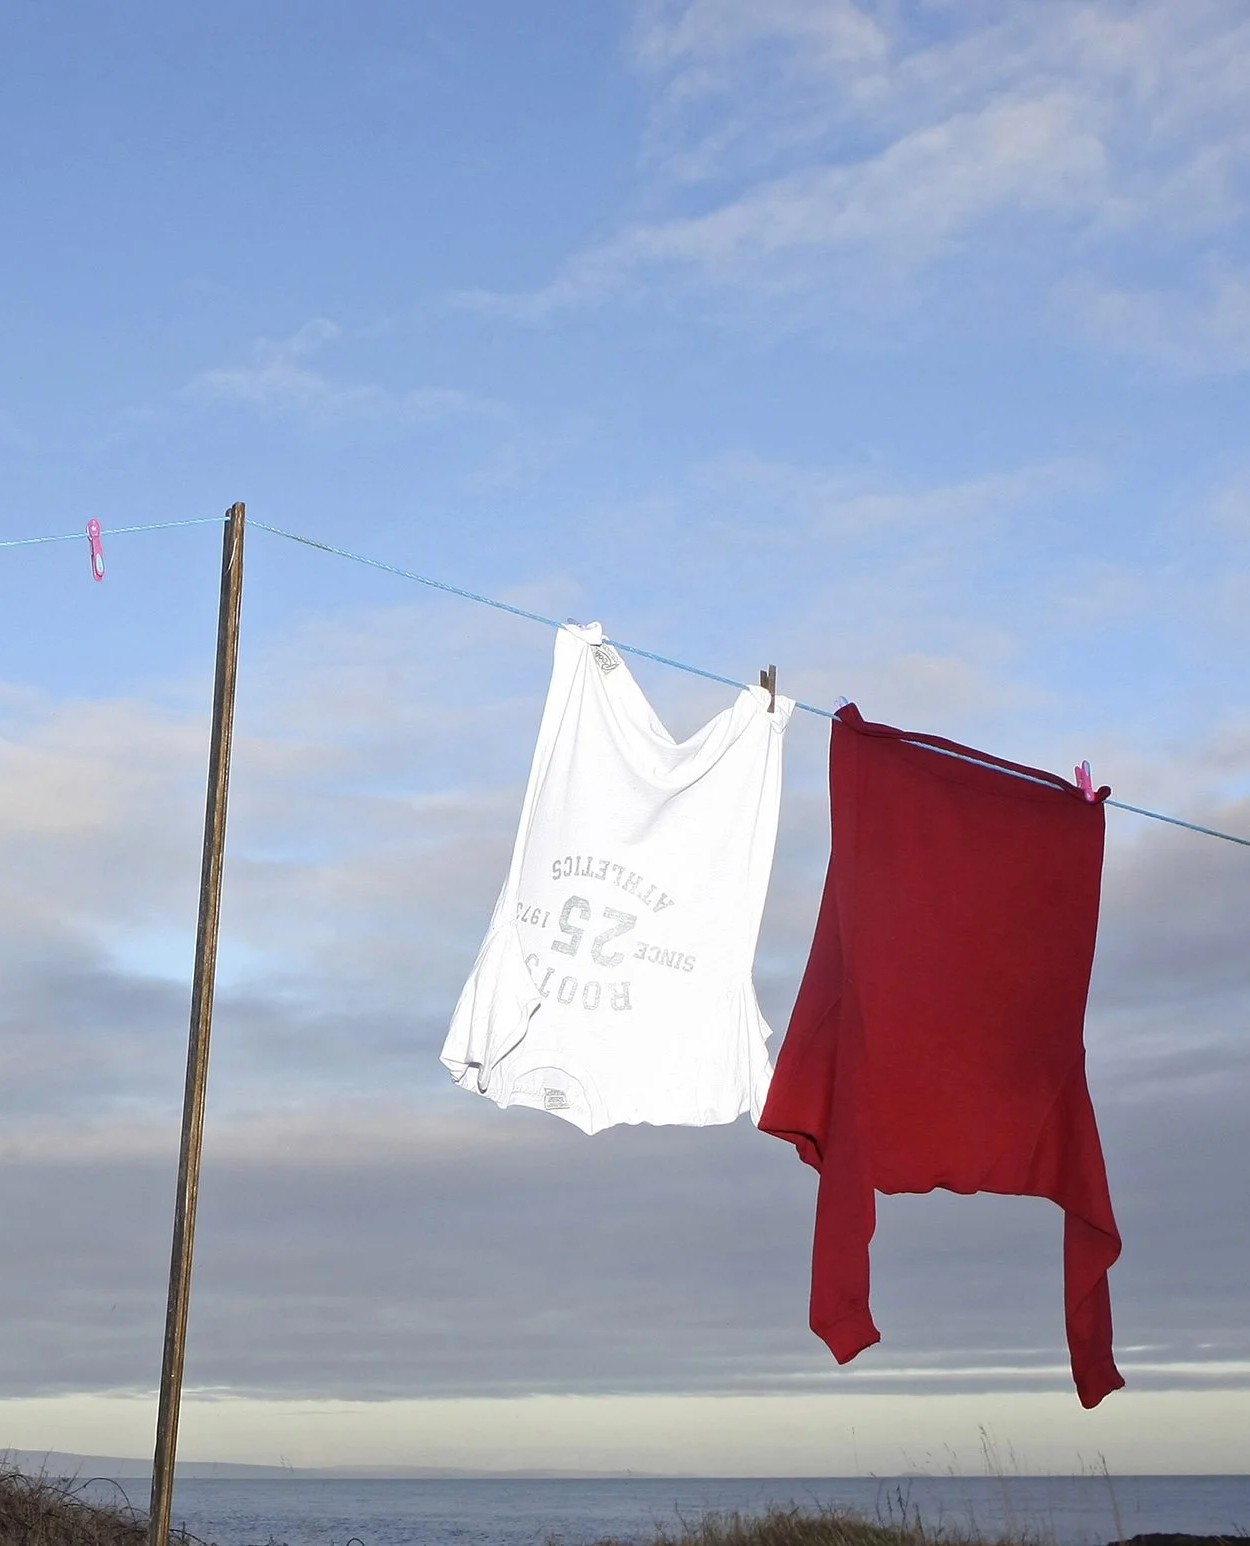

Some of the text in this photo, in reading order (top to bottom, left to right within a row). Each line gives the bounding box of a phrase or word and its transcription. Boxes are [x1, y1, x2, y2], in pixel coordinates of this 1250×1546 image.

[552, 856, 674, 912] ATHLETICS
[551, 895, 637, 968] 25
[633, 942, 696, 972] SINCE
